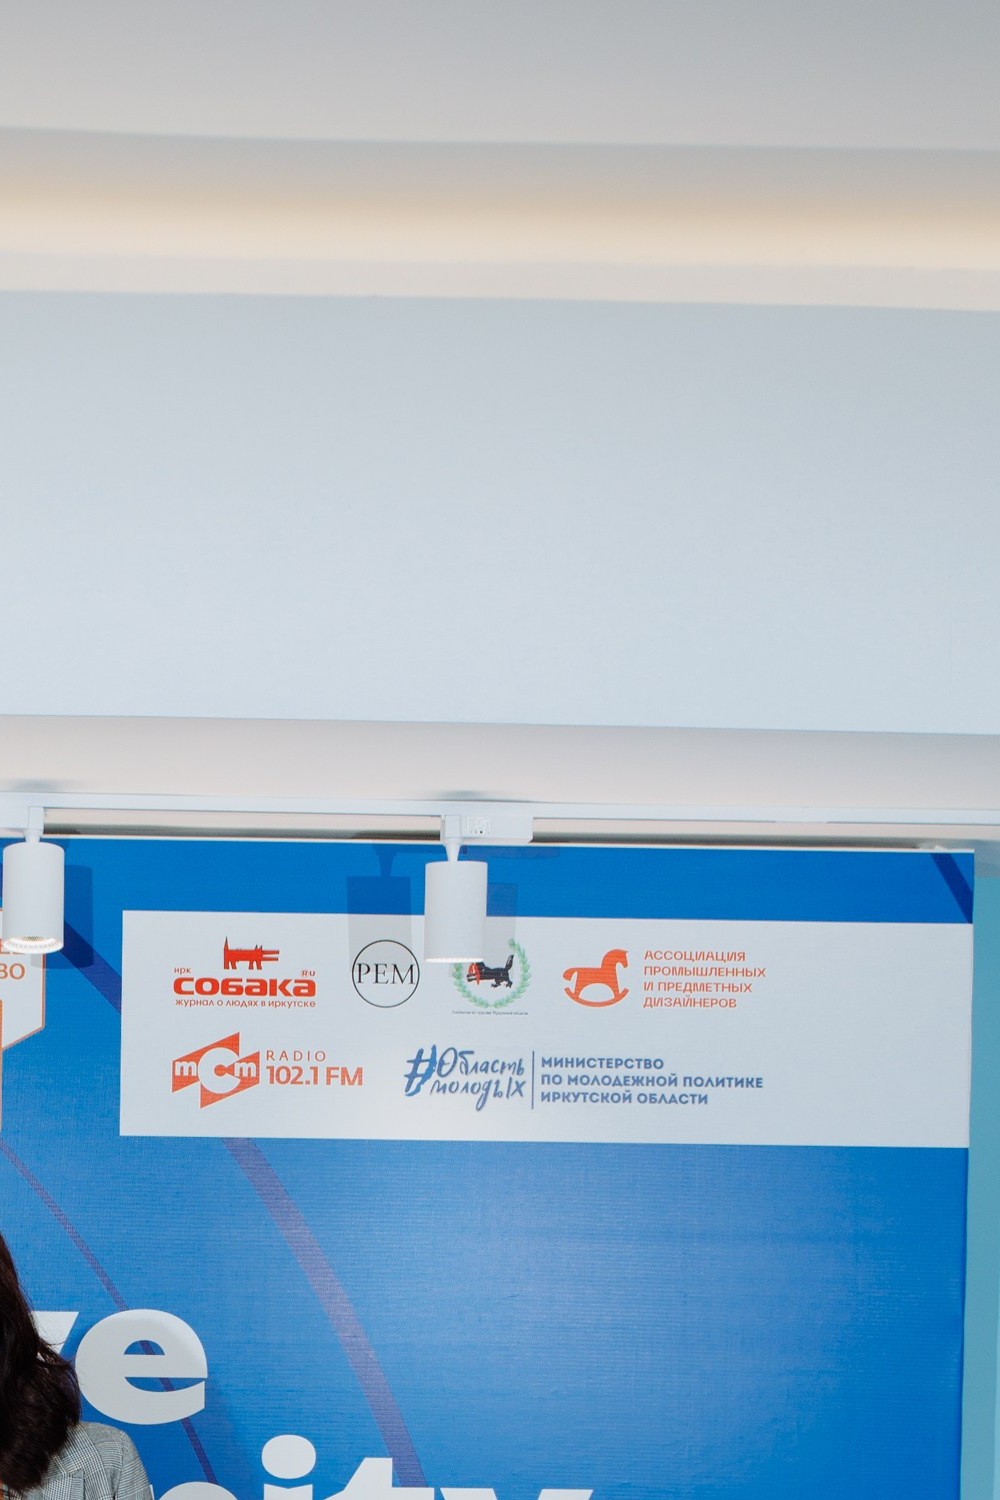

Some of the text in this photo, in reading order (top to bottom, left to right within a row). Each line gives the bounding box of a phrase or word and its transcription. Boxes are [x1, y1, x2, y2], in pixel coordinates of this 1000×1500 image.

[644, 950, 746, 963] АССОЦИАЦИЯ
[644, 966, 766, 978] ПРОМЫШЛЕННЫХ
[173, 977, 316, 997] собака
[644, 982, 752, 995] И ПРЕДМЕТНЫХ
[175, 999, 214, 1007] журнал
[643, 994, 737, 1008] ДИЗАЙНЕРОВ
[266, 1050, 326, 1062] RADIO
[541, 1057, 664, 1070] МИНИСТЕРСТВО
[266, 1066, 363, 1086] 102.1 FM
[541, 1072, 764, 1089] ПО МОЛОДЕЖНОЙ ПОЛИТИКЕ
[430, 1077, 526, 1111] молодых
[541, 1090, 709, 1105] ИРКУТСКОЙ ОБЛАСТИ
